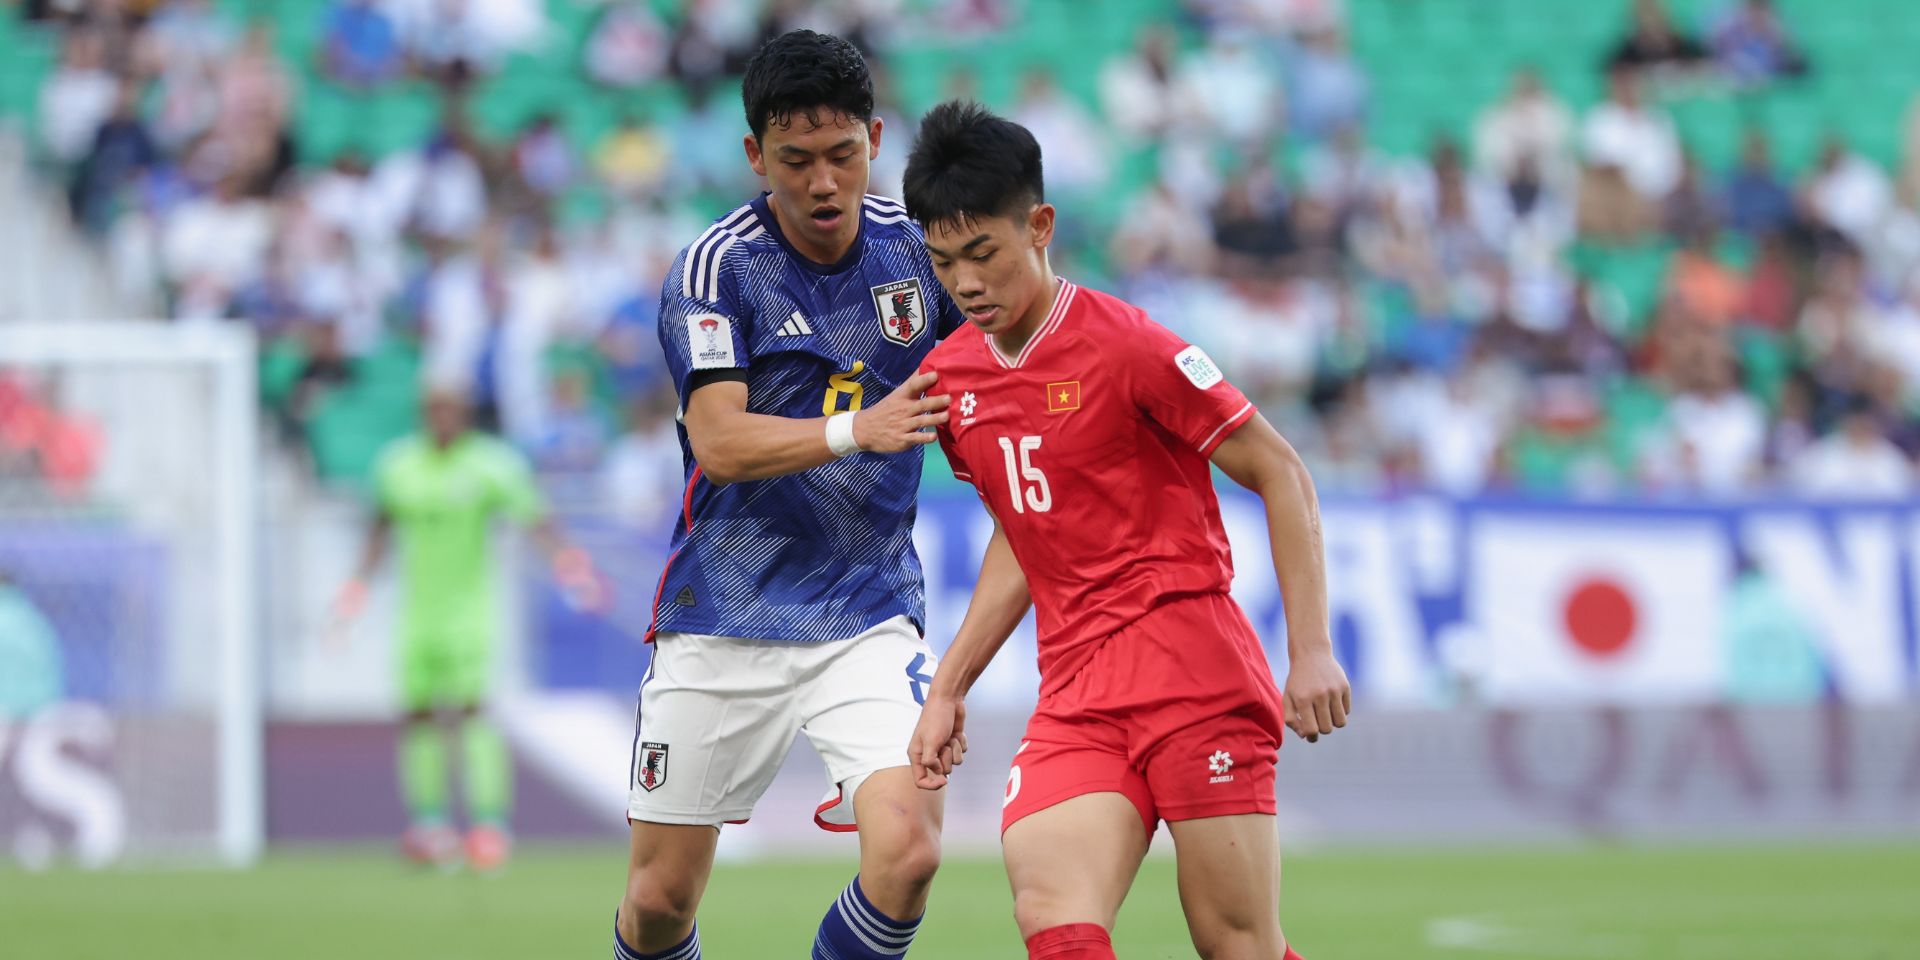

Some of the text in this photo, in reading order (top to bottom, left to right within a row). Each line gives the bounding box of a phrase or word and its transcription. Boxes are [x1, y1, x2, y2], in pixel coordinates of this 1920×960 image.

[884, 282, 909, 293] JAPAN
[1182, 355, 1194, 367] AFC
[998, 435, 1052, 514] 15
